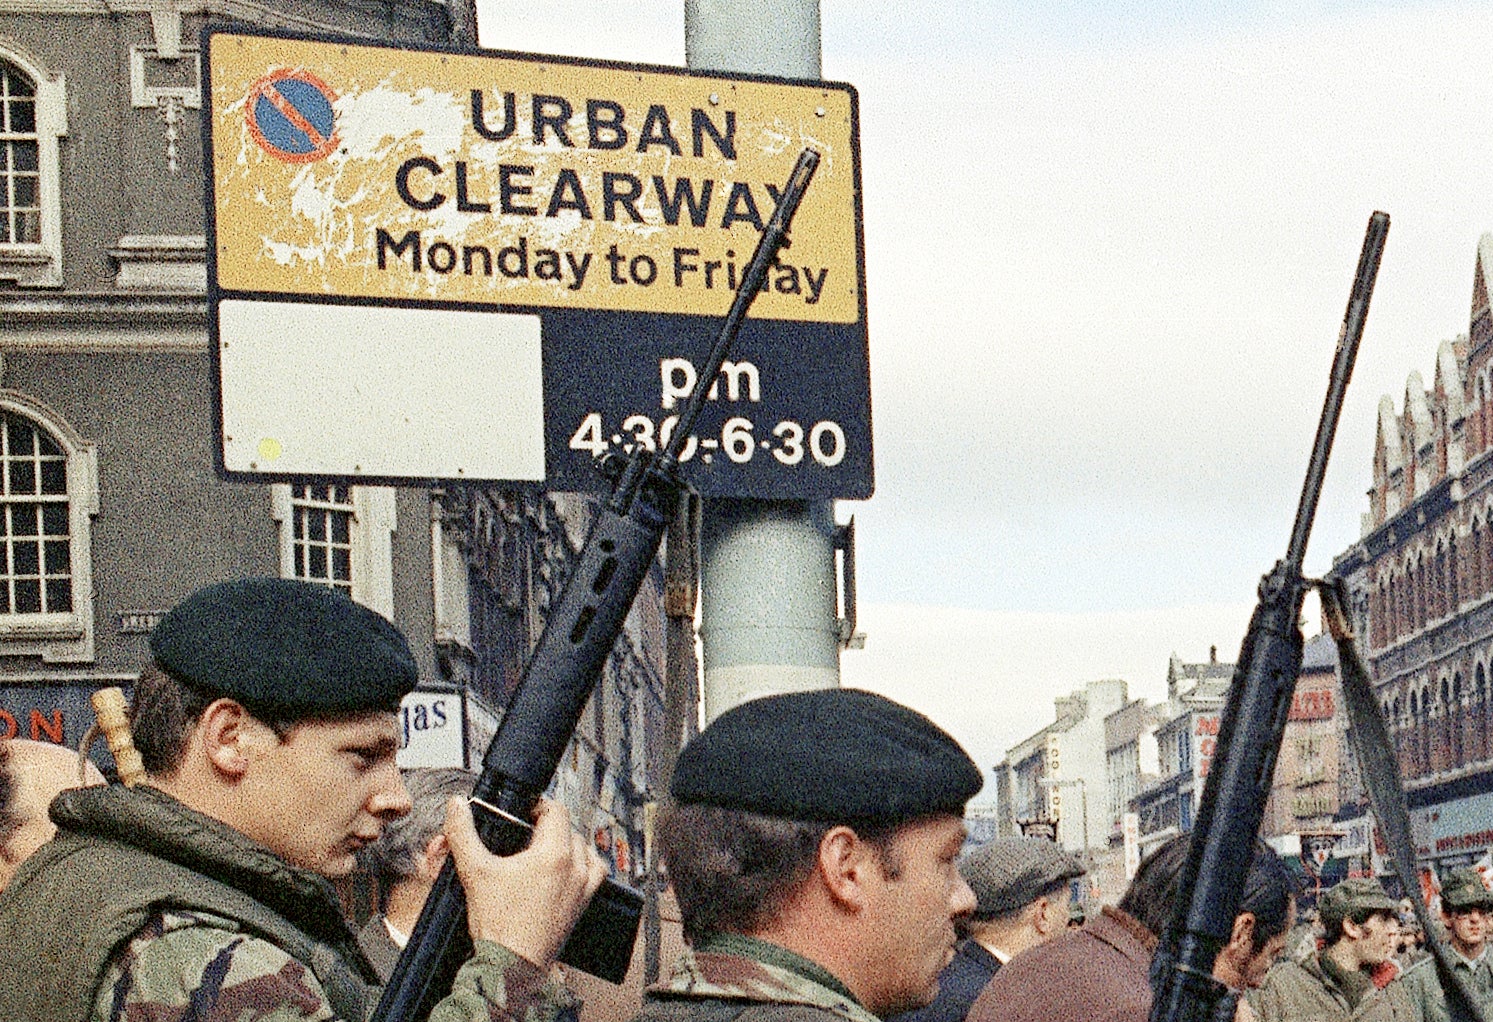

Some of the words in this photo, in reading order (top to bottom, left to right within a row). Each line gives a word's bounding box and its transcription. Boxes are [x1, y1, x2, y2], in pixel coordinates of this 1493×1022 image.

[471, 88, 737, 161] URBAN
[377, 228, 594, 291] Monday
[608, 242, 658, 286] to
[673, 247, 829, 304] Friay
[660, 357, 761, 409] pm
